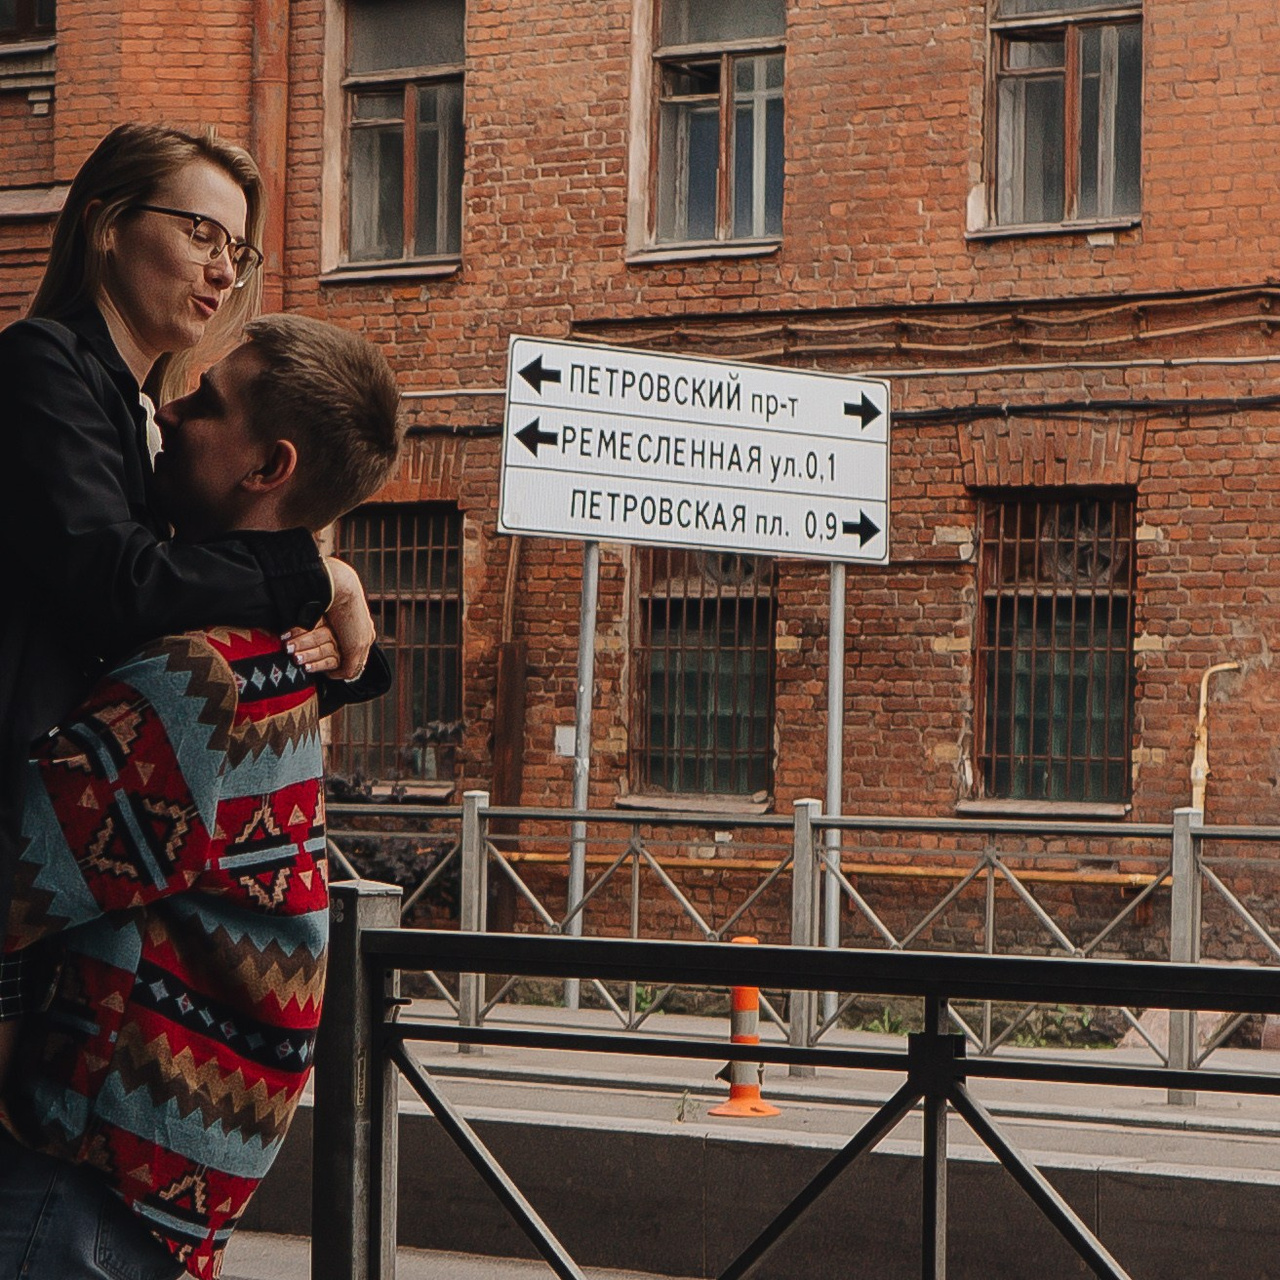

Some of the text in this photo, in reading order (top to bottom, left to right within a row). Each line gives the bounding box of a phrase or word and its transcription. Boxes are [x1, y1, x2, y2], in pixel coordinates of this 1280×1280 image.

[569, 362, 799, 422] ПЕТРОВСКИЙ пр-т
[561, 425, 762, 474] РЕМЕСЛЕННАЯ
[570, 488, 838, 541] ПЕТРОВСКАЯ пл. 0,9
